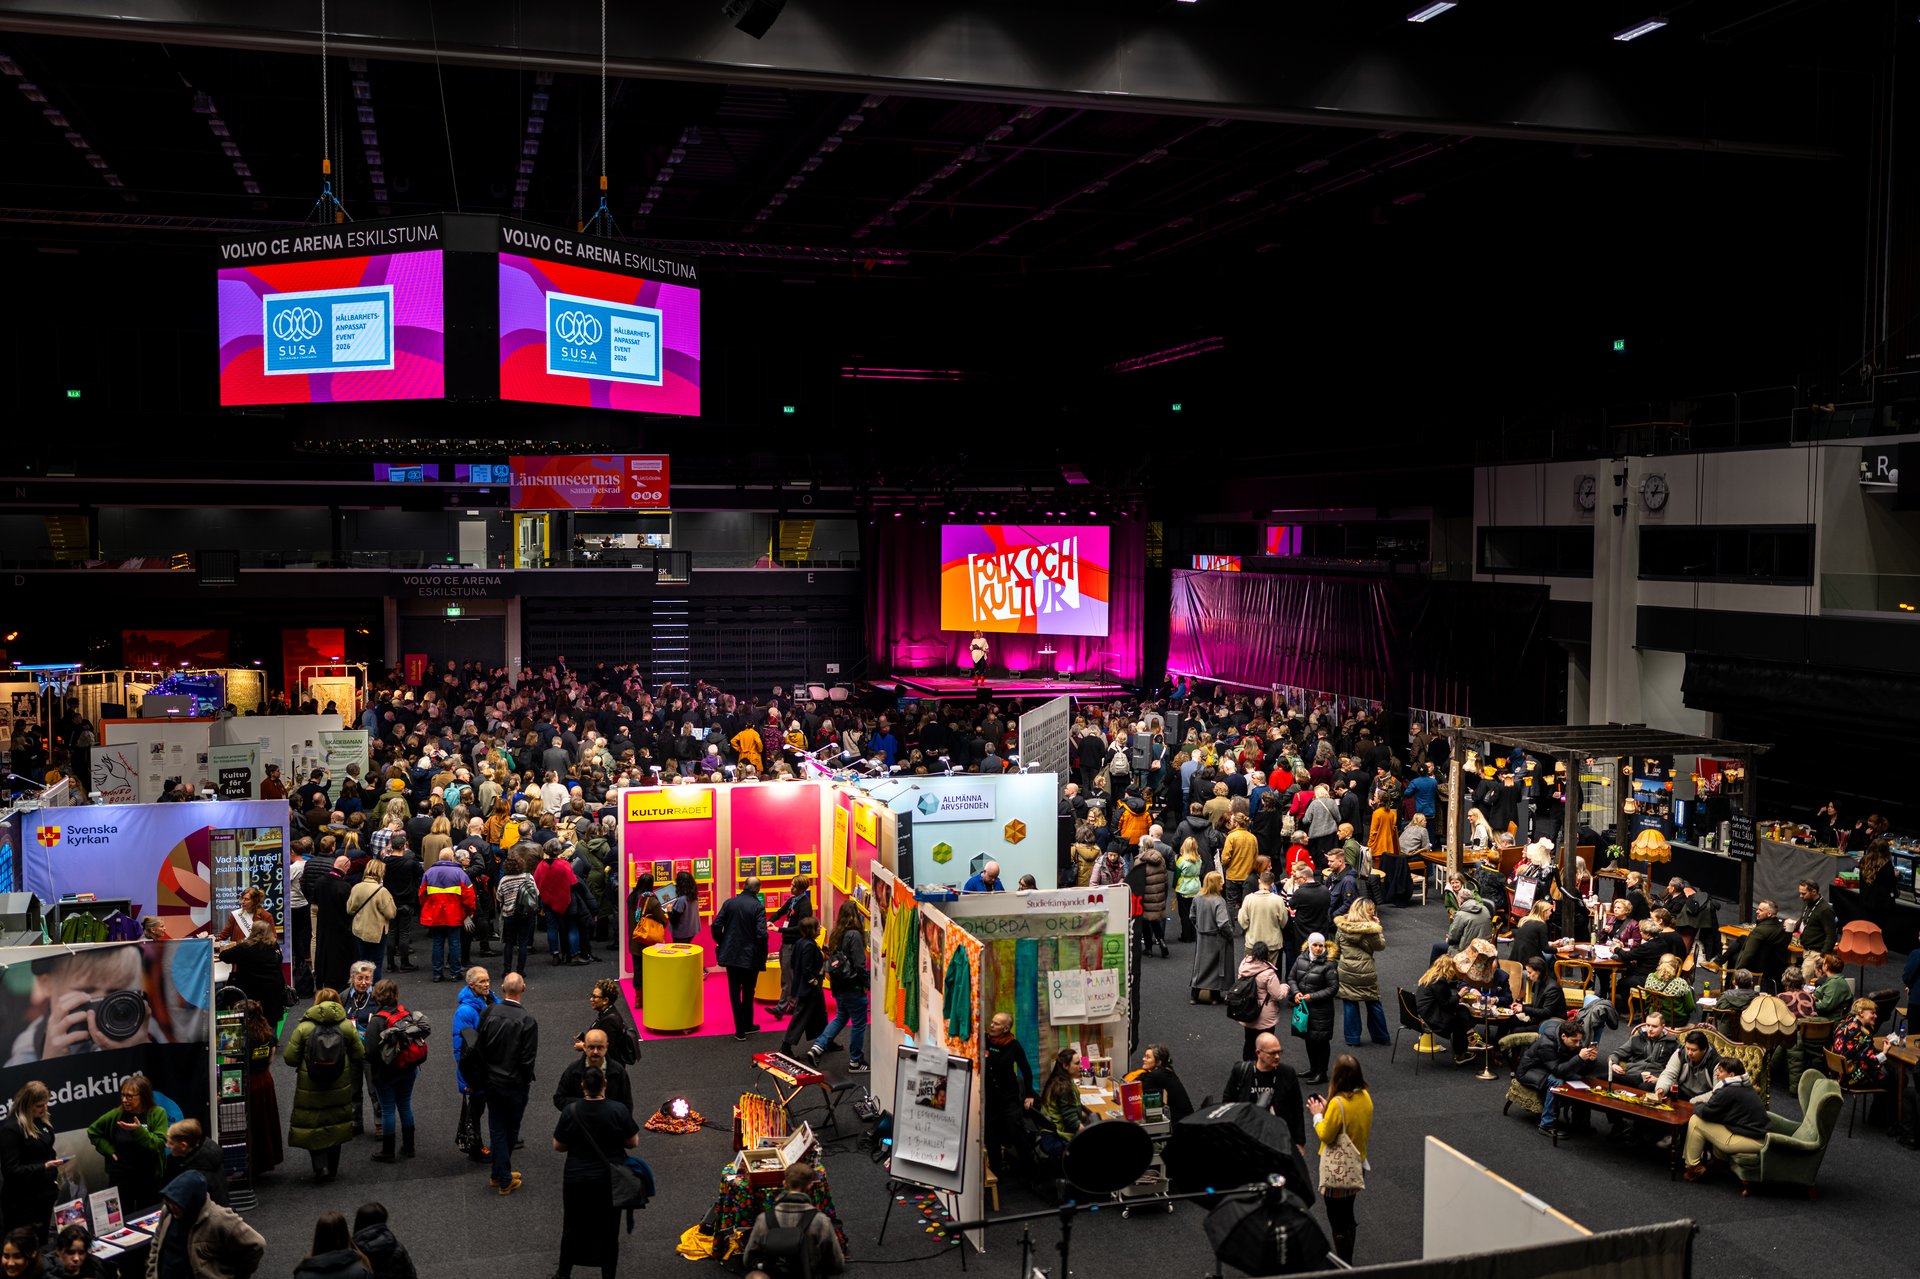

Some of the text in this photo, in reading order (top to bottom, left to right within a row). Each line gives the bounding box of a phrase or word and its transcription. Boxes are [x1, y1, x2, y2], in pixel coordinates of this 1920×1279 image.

[221, 224, 439, 259] VOLVO CE ARENA ESKILSTUNA
[503, 227, 697, 280] VOLVO CE ARENA ESKILSTUNA
[335, 323, 367, 332] ANPASSAT
[335, 333, 355, 341] EVENT
[613, 336, 641, 346] ANPASSAT
[279, 344, 317, 356] SUSA
[561, 346, 597, 361] SUSA
[613, 345, 631, 353] EVENT
[614, 354, 627, 362] 2026
[1877, 455, 1889, 476] R
[510, 472, 620, 486] Länsmuseernas
[15, 485, 26, 499] N
[973, 537, 1075, 585] FOLK OCH
[14, 573, 26, 587] D
[403, 576, 502, 585] VOLVO CE ARENA
[807, 572, 815, 583] E
[418, 587, 487, 596] ESKILSTUNA
[973, 571, 1074, 622] KULTUR
[222, 771, 248, 779] Kultur
[229, 779, 241, 787] för
[101, 788, 132, 797] ANNED
[226, 787, 245, 795] livet
[942, 794, 983, 803] ALLMÄNNA
[940, 802, 989, 811] ARVSFONDEN
[67, 824, 118, 835] Svenska
[67, 834, 110, 847] kyrkan
[215, 856, 232, 864] Vad
[696, 860, 710, 869] MU
[1045, 915, 1082, 930] ORD
[1087, 975, 1115, 986] PLAKAT
